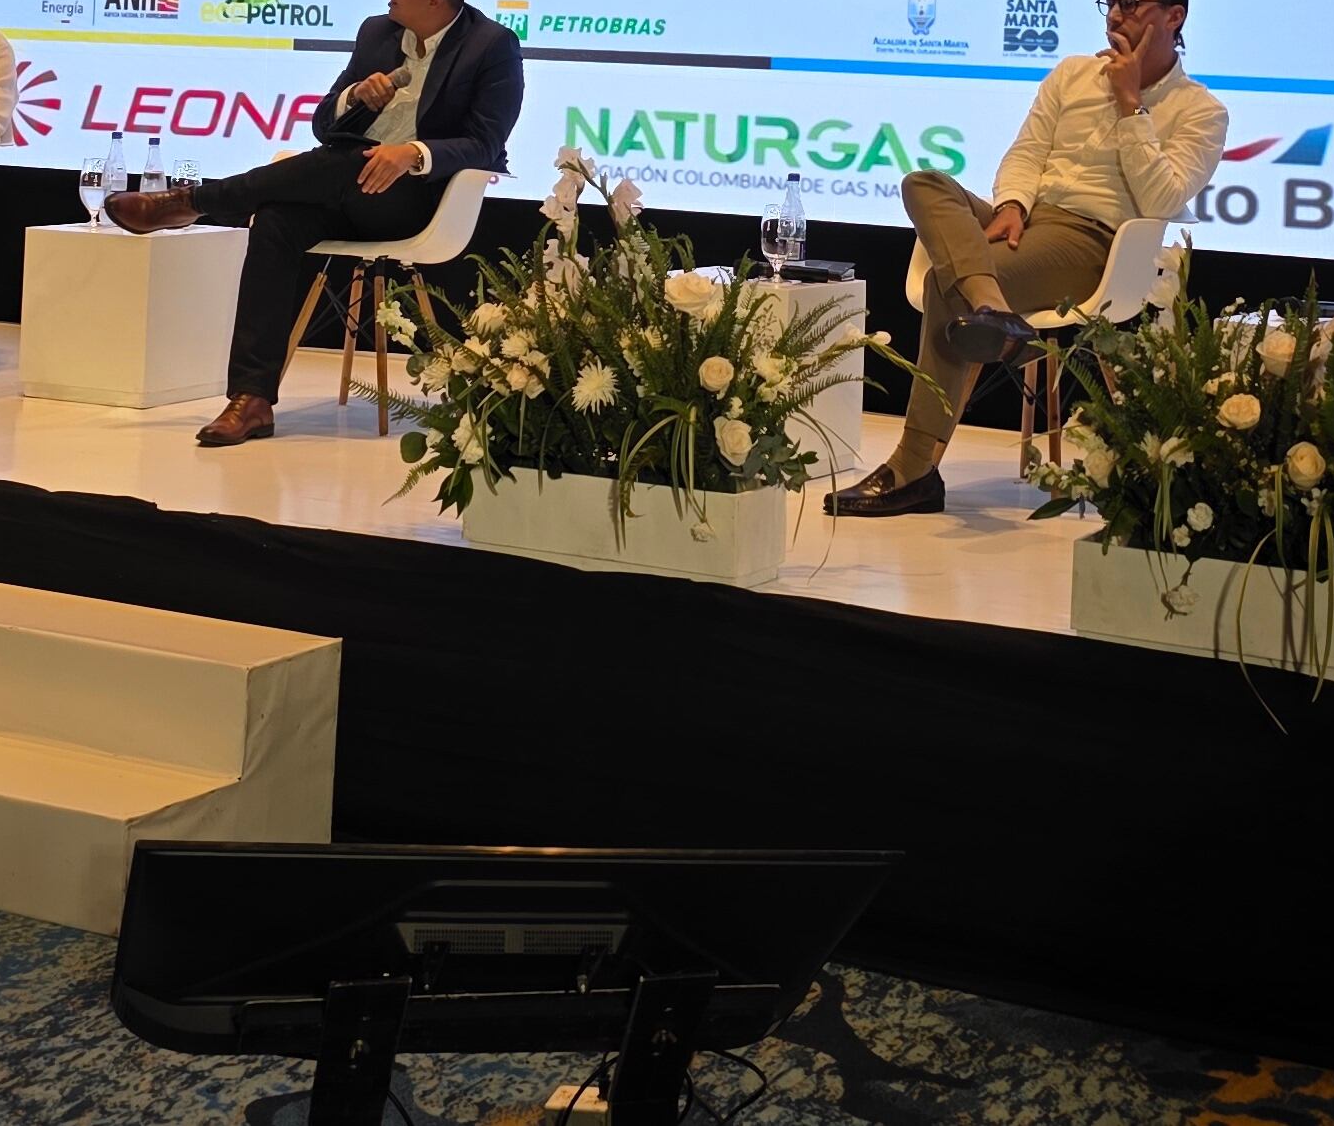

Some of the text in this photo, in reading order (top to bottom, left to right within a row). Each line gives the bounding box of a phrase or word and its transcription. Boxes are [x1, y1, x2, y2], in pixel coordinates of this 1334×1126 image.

[41, 0, 84, 17] Energía
[1006, 0, 1058, 13] SANTA
[539, 15, 666, 36] PETROBRAS
[1004, 13, 1059, 28] MARTA
[565, 105, 966, 177] NATURGAS
[801, 177, 824, 193] DE
[831, 179, 868, 197] GAS
[1195, 184, 1260, 226] to
